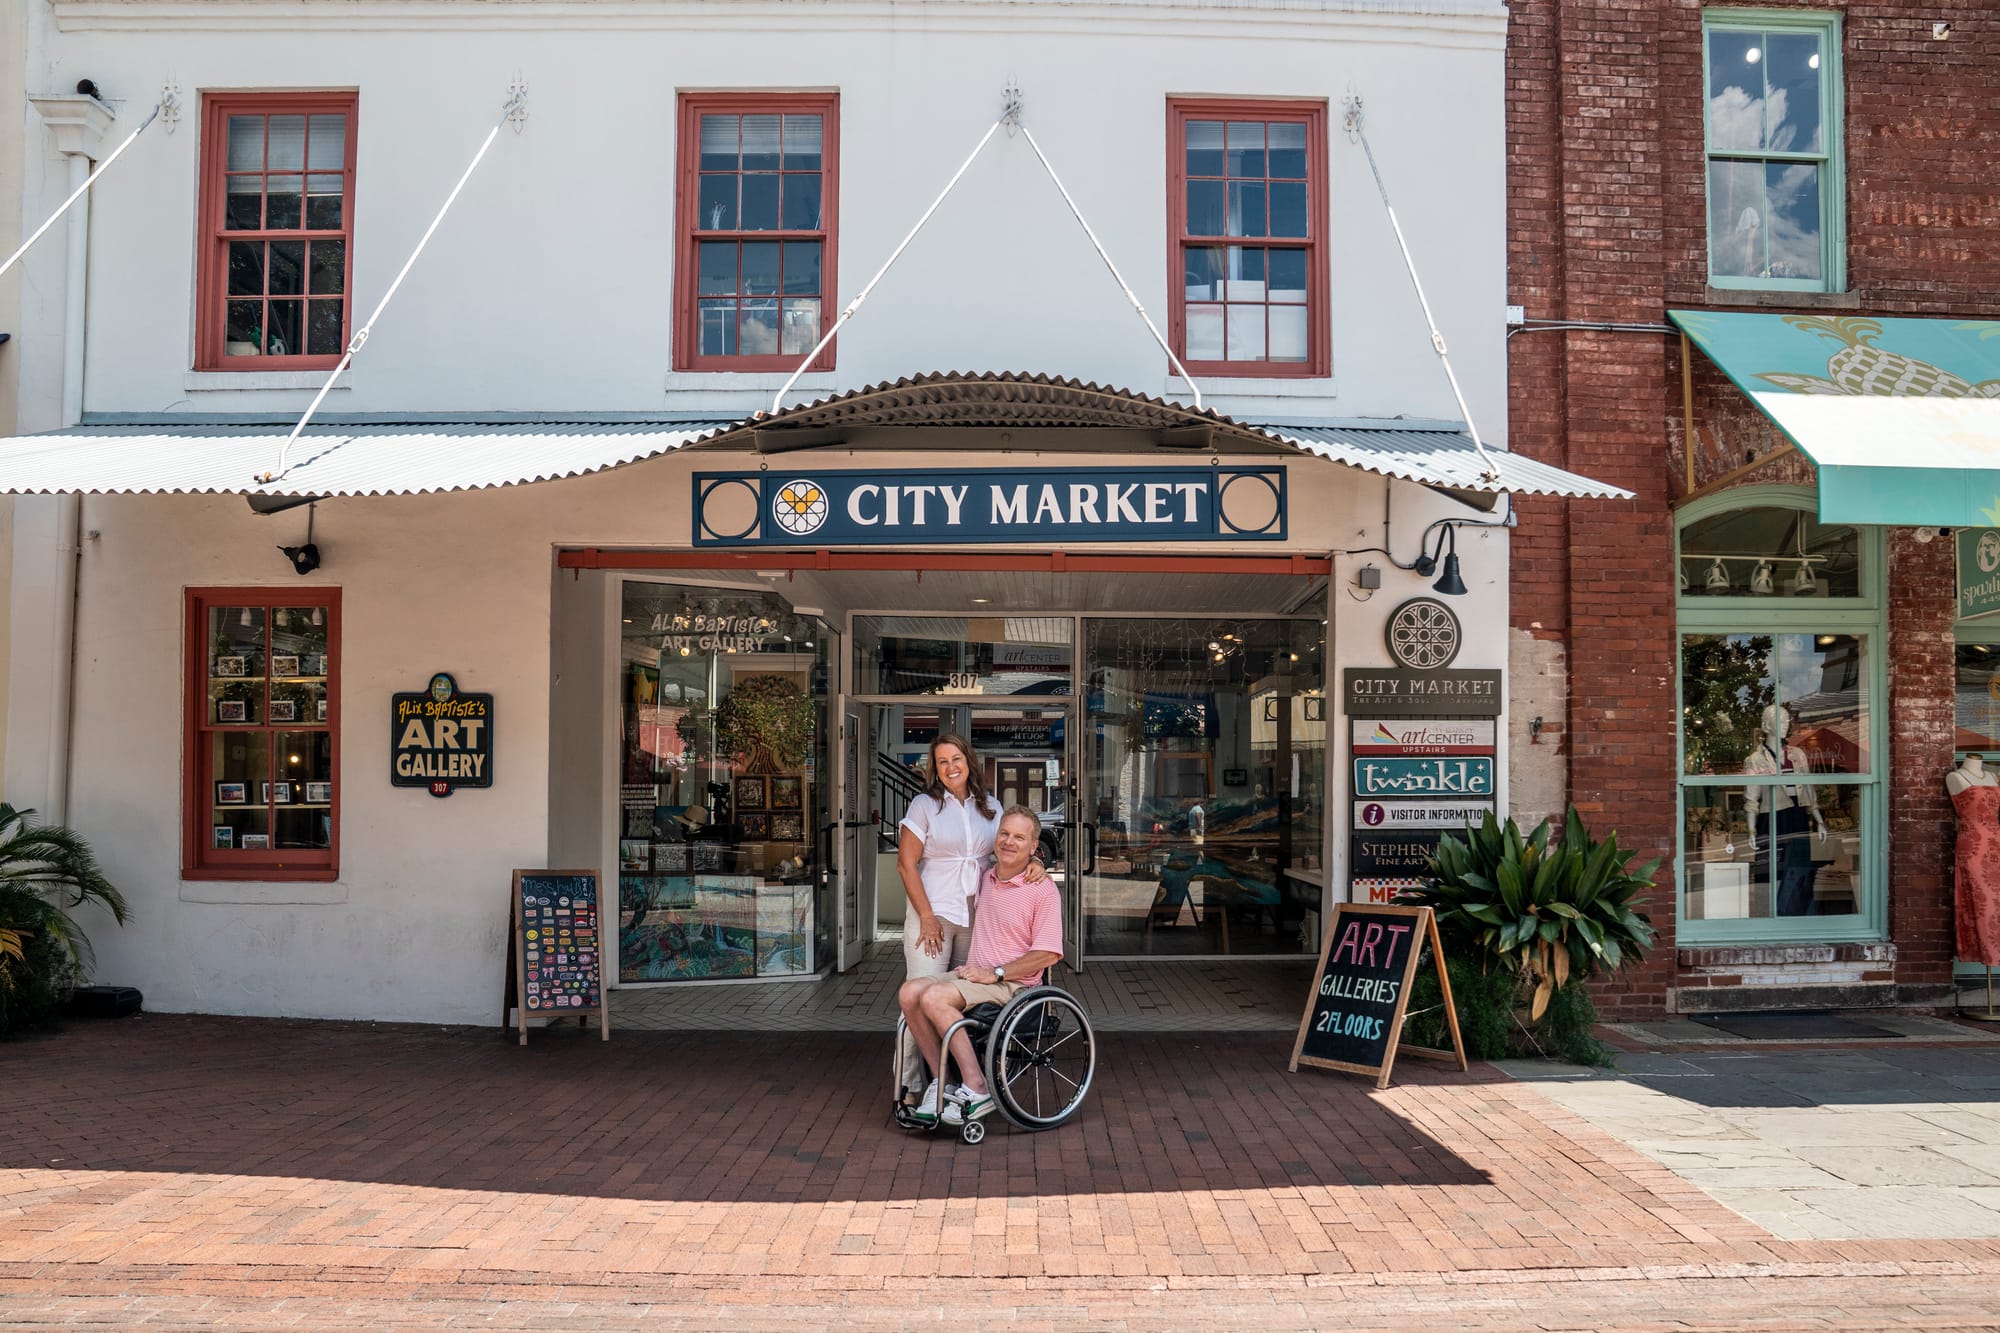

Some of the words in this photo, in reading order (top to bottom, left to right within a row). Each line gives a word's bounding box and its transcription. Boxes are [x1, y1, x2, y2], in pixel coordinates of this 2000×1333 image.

[846, 484, 969, 526] CITY
[989, 482, 1207, 525] MARKET
[661, 636, 692, 649] ART
[699, 636, 764, 651] GALLERY
[951, 673, 978, 689] 307
[1353, 679, 1400, 694] CITY
[1410, 680, 1494, 695] MARKET
[398, 719, 485, 749] ART
[396, 753, 485, 777] GALLERY
[1363, 760, 1486, 793] twinkle
[434, 783, 447, 792] 307
[1391, 809, 1426, 820] VISITOR
[1429, 809, 1482, 820] INFORMATIO
[1362, 842, 1430, 856] STEPHEN
[1332, 921, 1410, 969] ART
[1320, 974, 1400, 1004] GALLERIES
